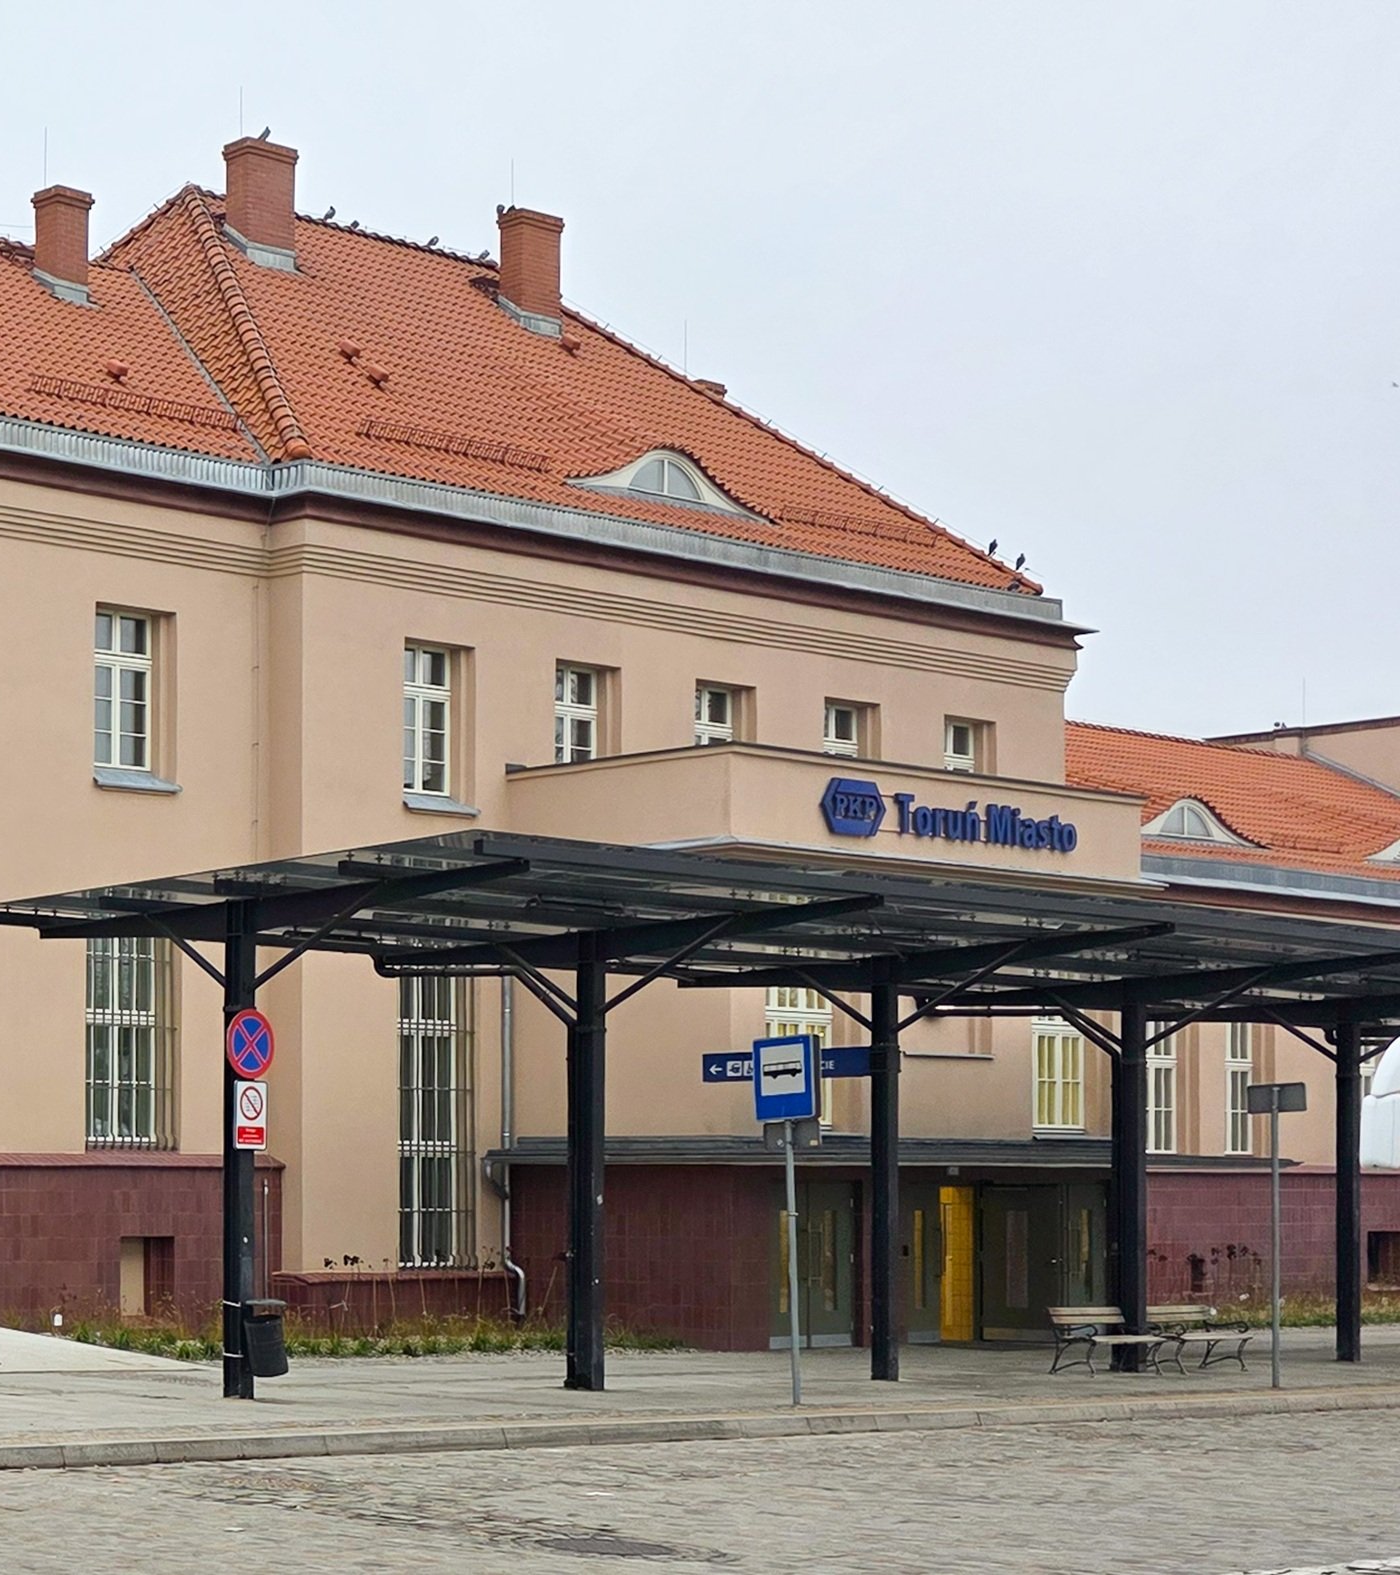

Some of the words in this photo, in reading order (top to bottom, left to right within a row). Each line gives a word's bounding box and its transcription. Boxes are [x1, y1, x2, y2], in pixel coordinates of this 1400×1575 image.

[834, 794, 878, 822] PKP
[894, 793, 980, 842] Toruń
[986, 803, 1077, 850] Miasto
